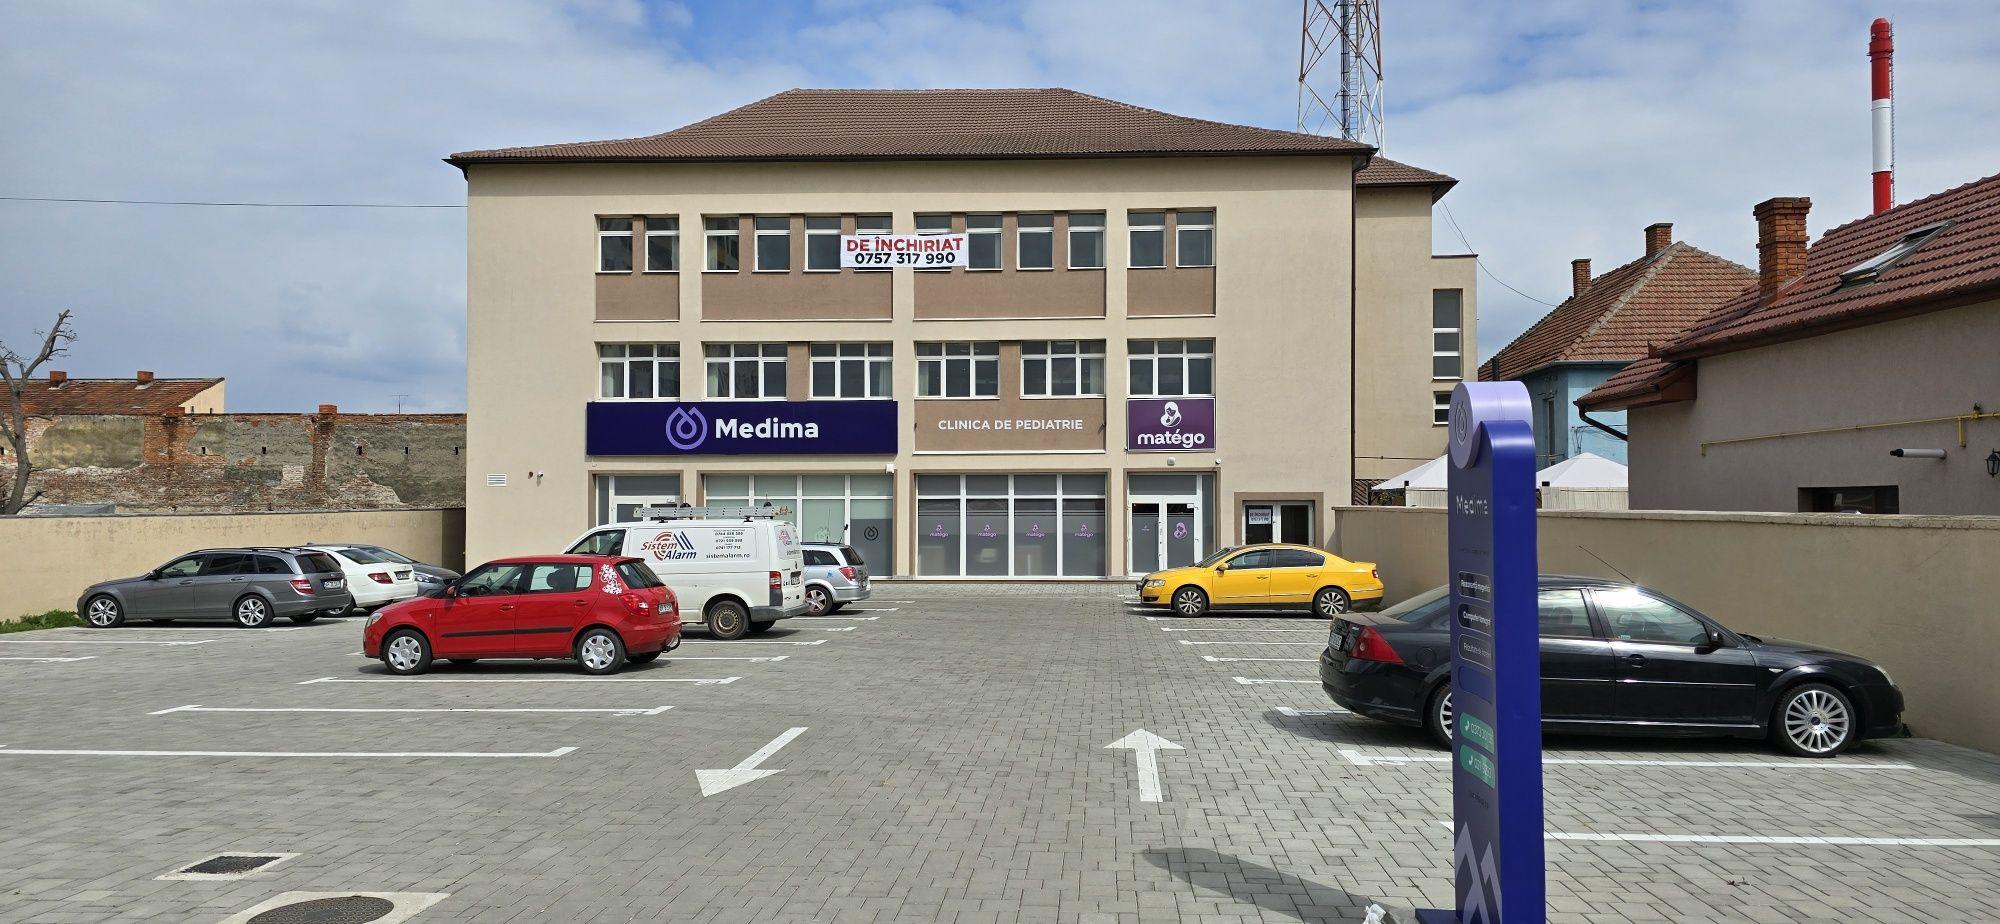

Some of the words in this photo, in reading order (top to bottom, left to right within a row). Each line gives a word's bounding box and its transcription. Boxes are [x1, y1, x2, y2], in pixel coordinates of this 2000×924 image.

[847, 239, 870, 252] DE
[874, 236, 964, 252] ÎNCHIRIAT
[855, 252, 892, 265] 0757
[896, 252, 921, 265] 317
[925, 252, 956, 265] 990
[715, 417, 819, 439] Medima
[938, 419, 991, 431] CLINICA
[994, 419, 1012, 431] DE
[1015, 419, 1083, 431] PEDIATRIE
[1137, 428, 1205, 449] matégo
[641, 541, 678, 550] Sistem
[664, 550, 697, 560] Alarm
